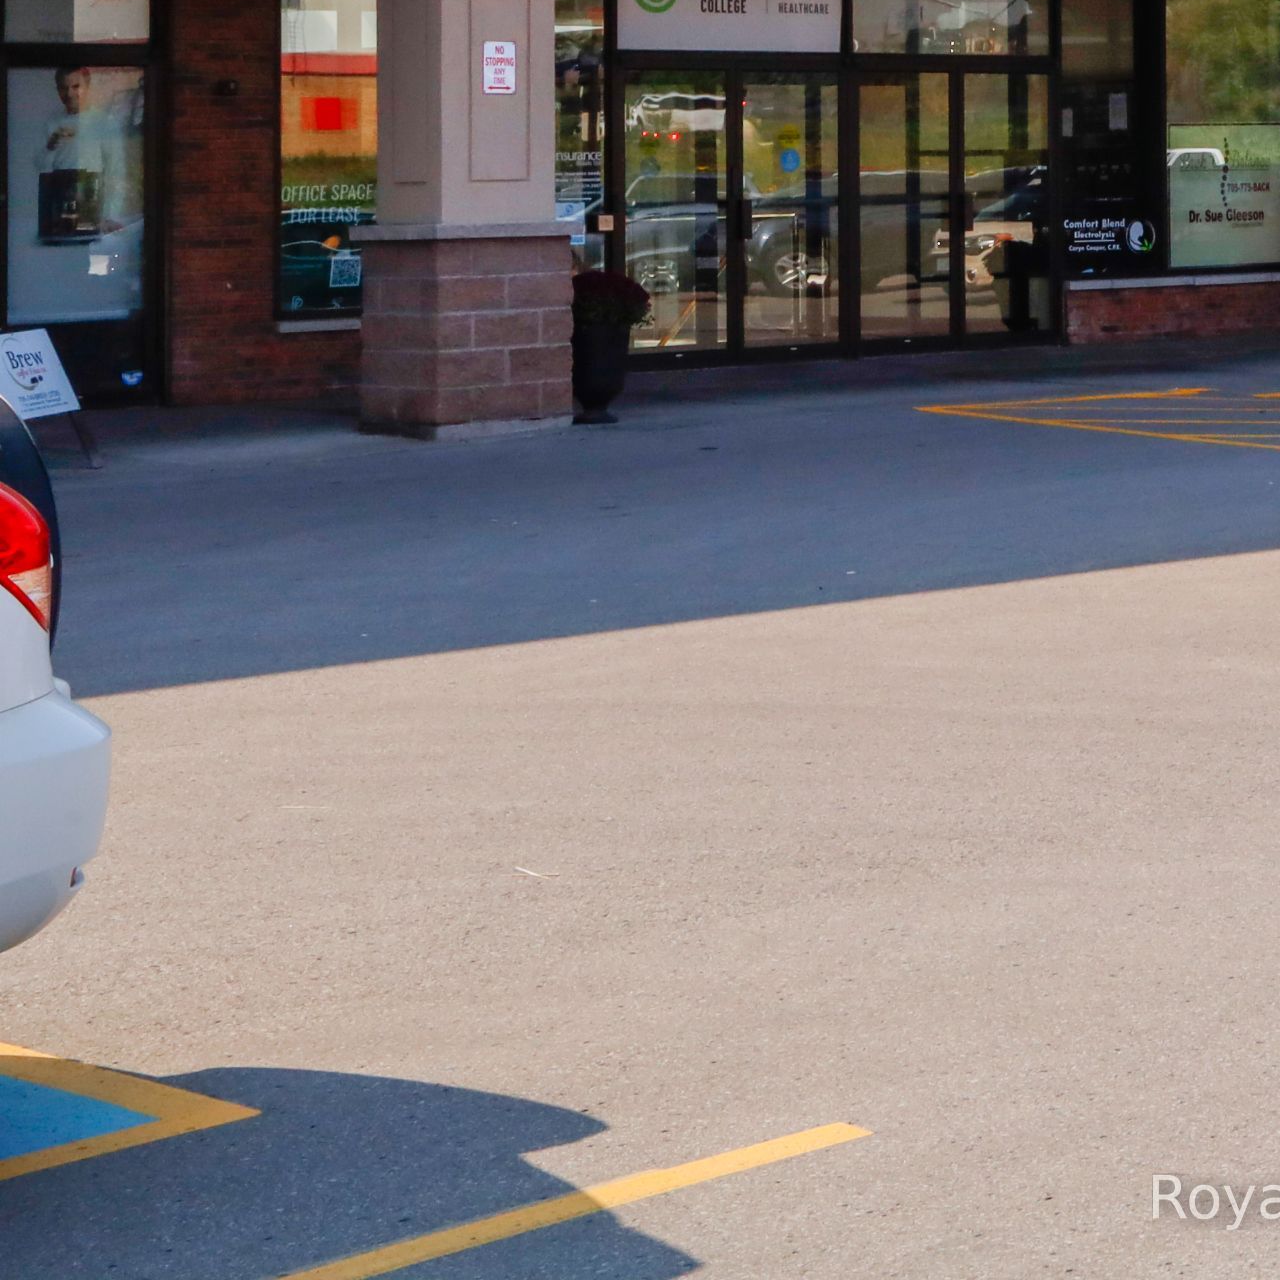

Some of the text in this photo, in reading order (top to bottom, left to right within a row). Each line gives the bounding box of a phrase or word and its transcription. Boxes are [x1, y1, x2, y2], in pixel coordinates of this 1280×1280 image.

[778, 2, 829, 15] HEALTHCARE
[495, 45, 504, 55] NO
[485, 56, 514, 67] STOPPING
[555, 151, 602, 161] nsurance
[281, 183, 375, 202] OFFICE SPACE
[1188, 208, 1264, 223] Dr. Sue Gleeson
[1063, 218, 1126, 229] Comfort Blend
[1074, 230, 1115, 240] Electrolysis
[5, 350, 44, 369] Brew
